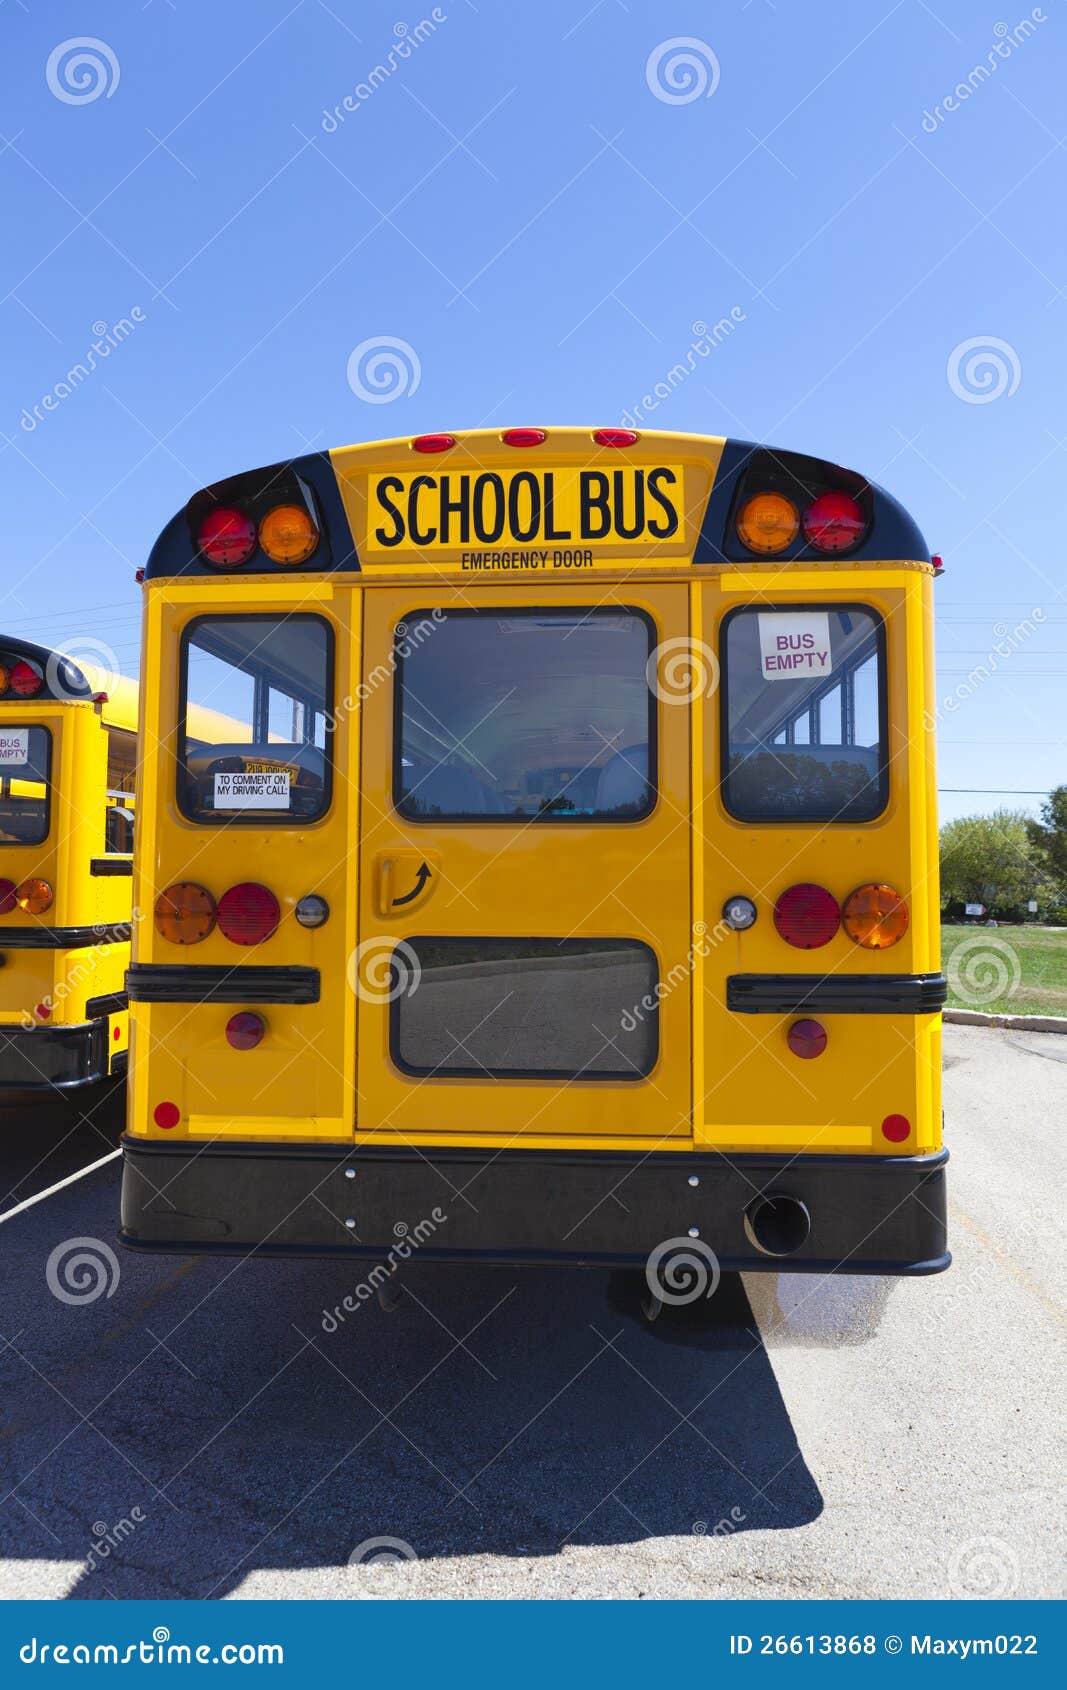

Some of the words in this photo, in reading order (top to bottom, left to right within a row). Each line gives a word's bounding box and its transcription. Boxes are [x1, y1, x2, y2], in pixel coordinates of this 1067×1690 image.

[375, 471, 571, 547] SCHOOL
[580, 467, 679, 540] BUS
[461, 551, 548, 570] EMERGENCY
[553, 550, 593, 568] DOOR
[776, 634, 815, 650] BUS
[765, 652, 828, 671] EMPTY
[0, 738, 20, 748] BUS
[0, 749, 26, 758] MPTY
[219, 775, 231, 785] TO
[232, 775, 272, 785] COMMENT
[273, 775, 286, 785] ON
[217, 786, 231, 795] MY
[232, 785, 264, 795] DRIVING
